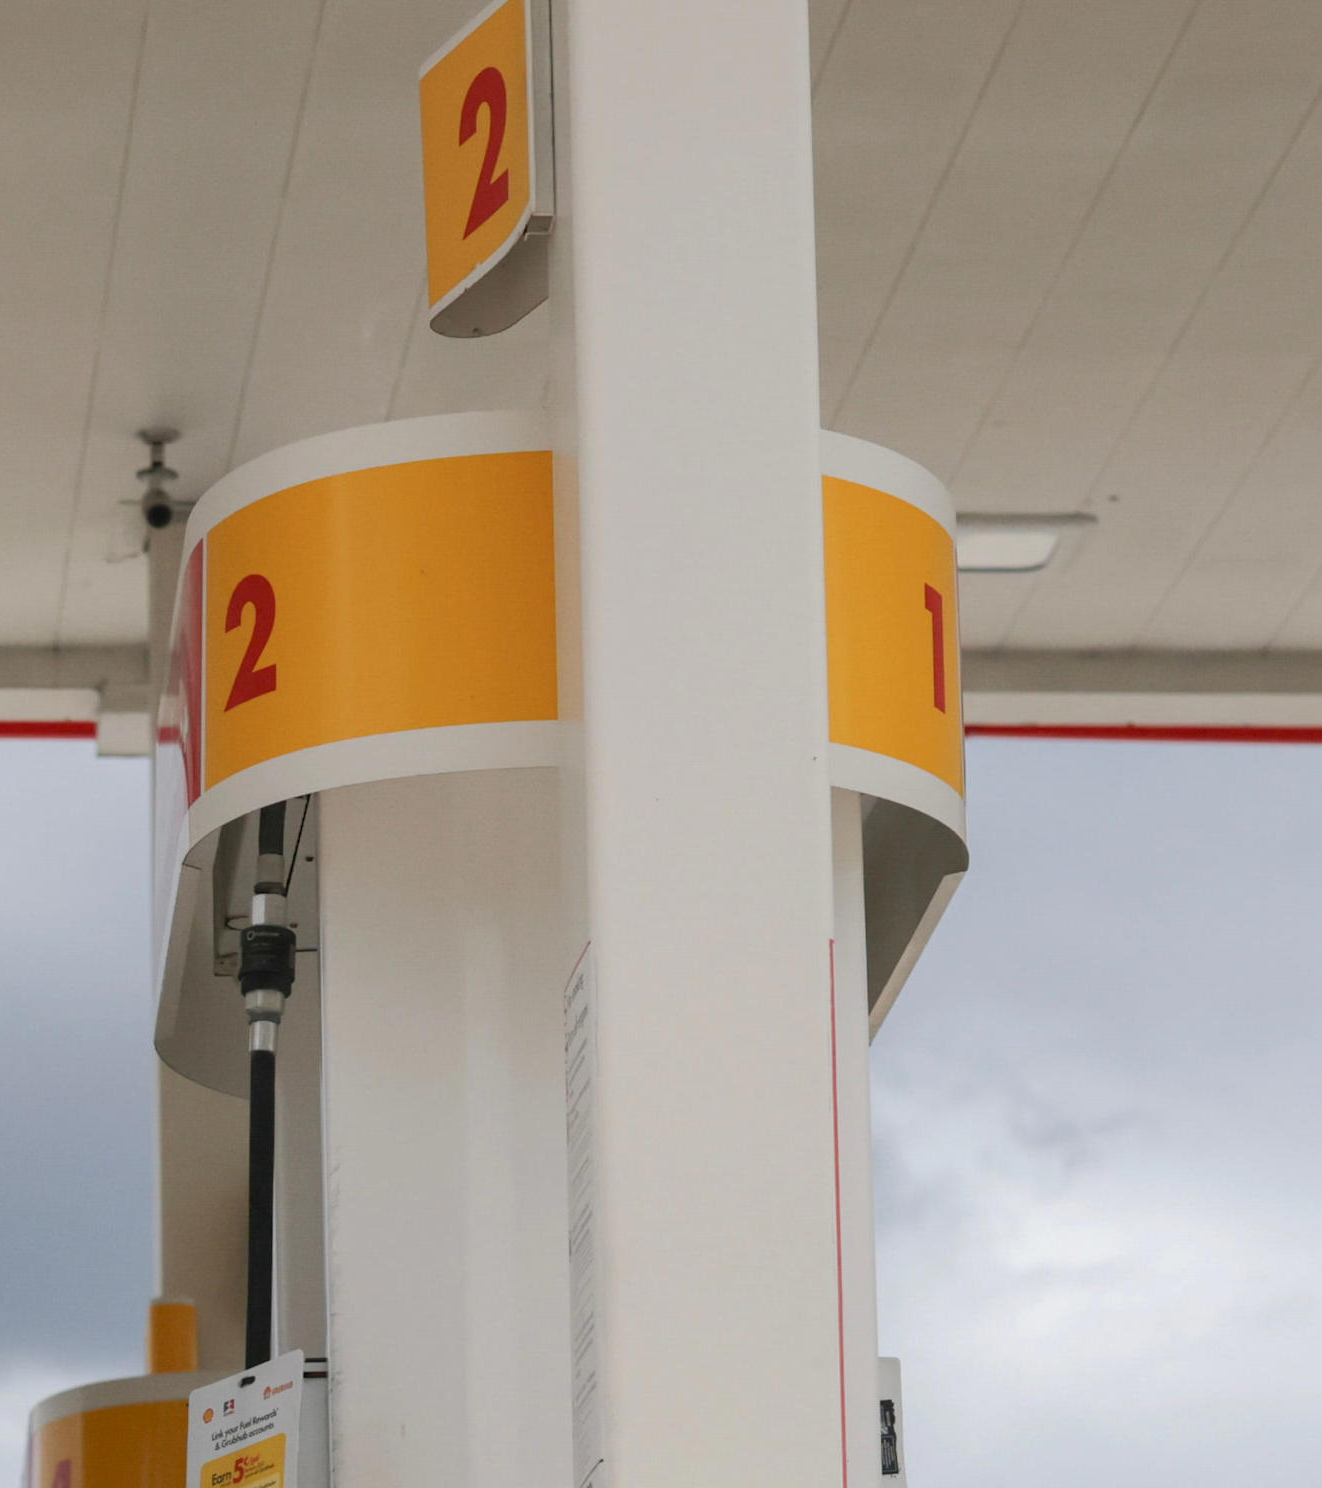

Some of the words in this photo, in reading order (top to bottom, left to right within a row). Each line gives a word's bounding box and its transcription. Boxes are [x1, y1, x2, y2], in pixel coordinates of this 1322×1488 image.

[458, 66, 510, 241] 2
[224, 573, 277, 713] 2
[924, 582, 946, 714] 1
[211, 1471, 232, 1486] Earn
[224, 1425, 239, 1438] your
